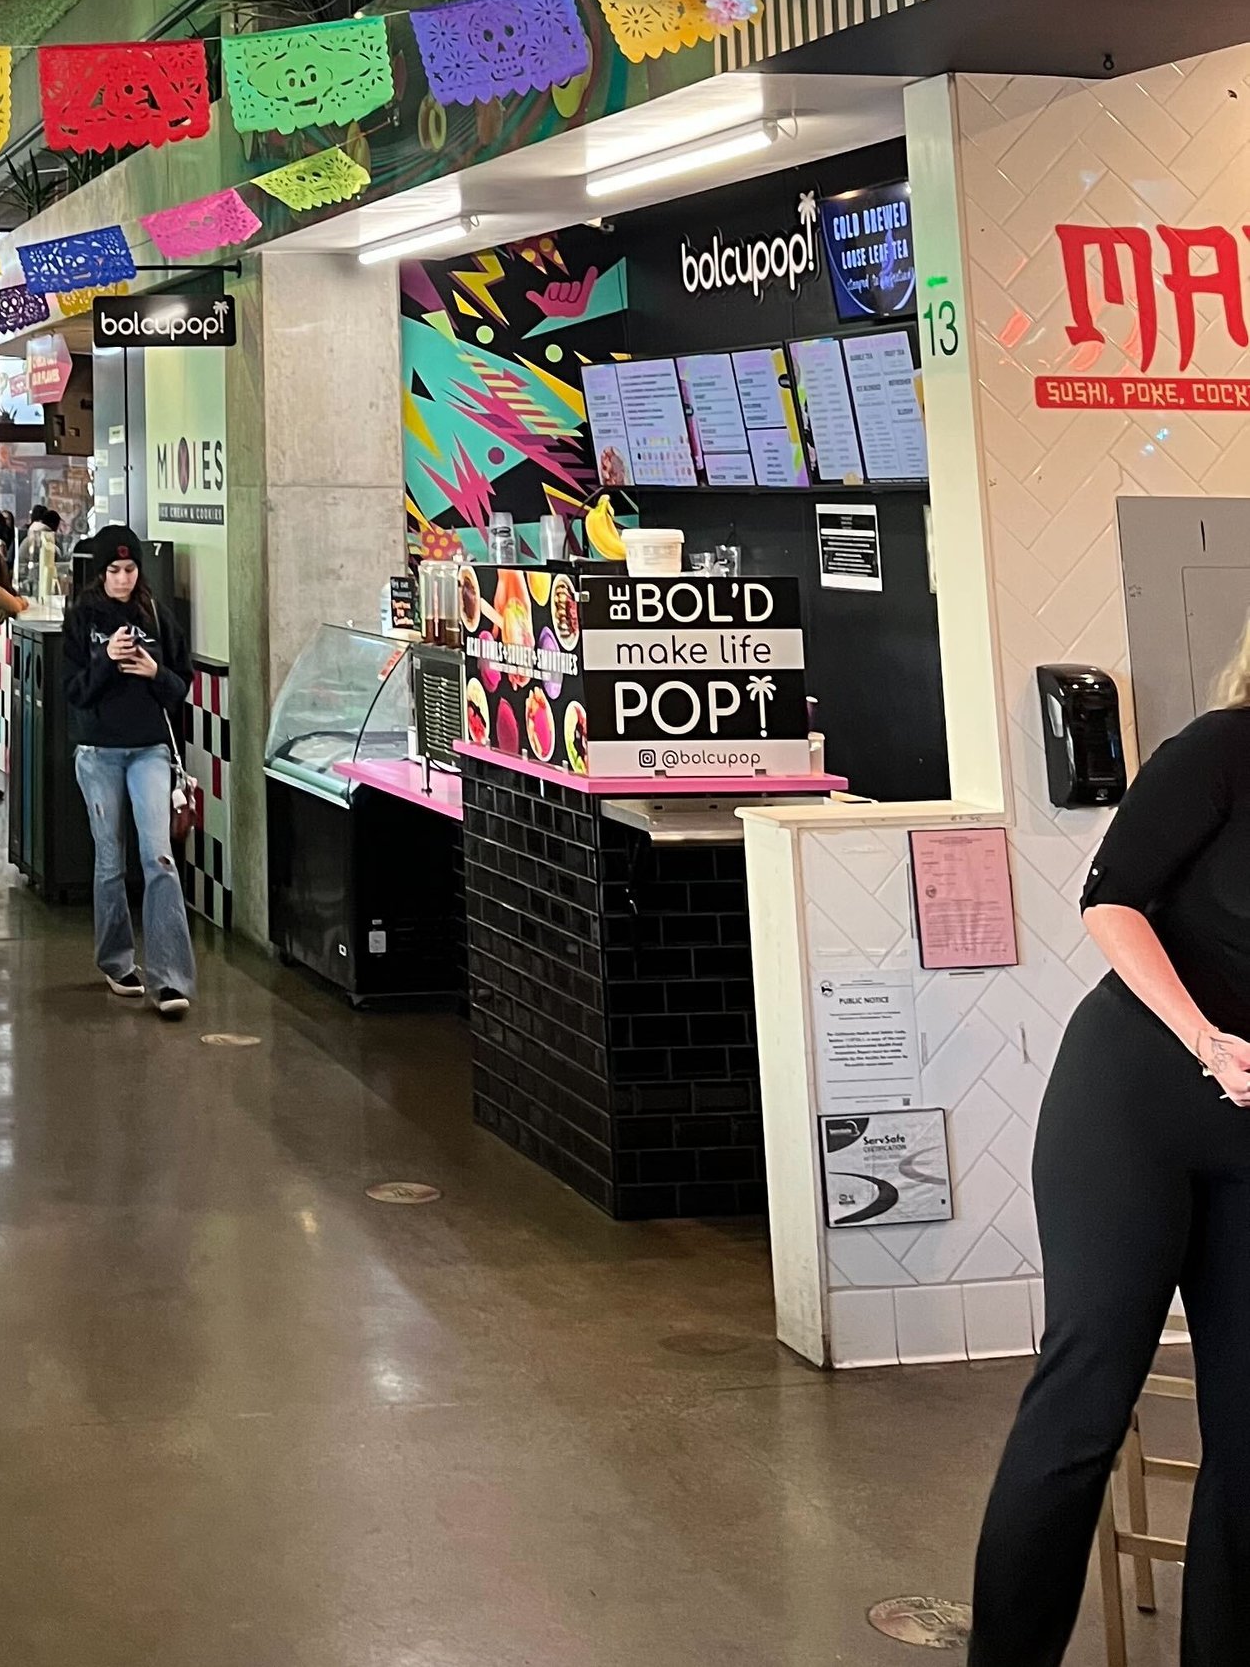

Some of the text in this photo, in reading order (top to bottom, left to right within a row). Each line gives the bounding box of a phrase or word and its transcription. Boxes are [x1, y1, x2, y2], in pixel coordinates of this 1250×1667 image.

[833, 201, 908, 241] COLD BREWED
[841, 238, 909, 270] LOOSE LEAF TEA
[1055, 224, 1250, 374] MA
[101, 302, 229, 340] bolcupop!
[922, 300, 959, 356] 13
[1045, 381, 1250, 407] SUSHI, POKE, COCK
[153, 543, 162, 556] 7
[609, 584, 631, 620] BE
[616, 634, 772, 665] make life
[661, 748, 761, 768] @bolcupop
[839, 996, 889, 1005] PUBLIC NOTICE
[863, 1134, 906, 1145] ServSafe
